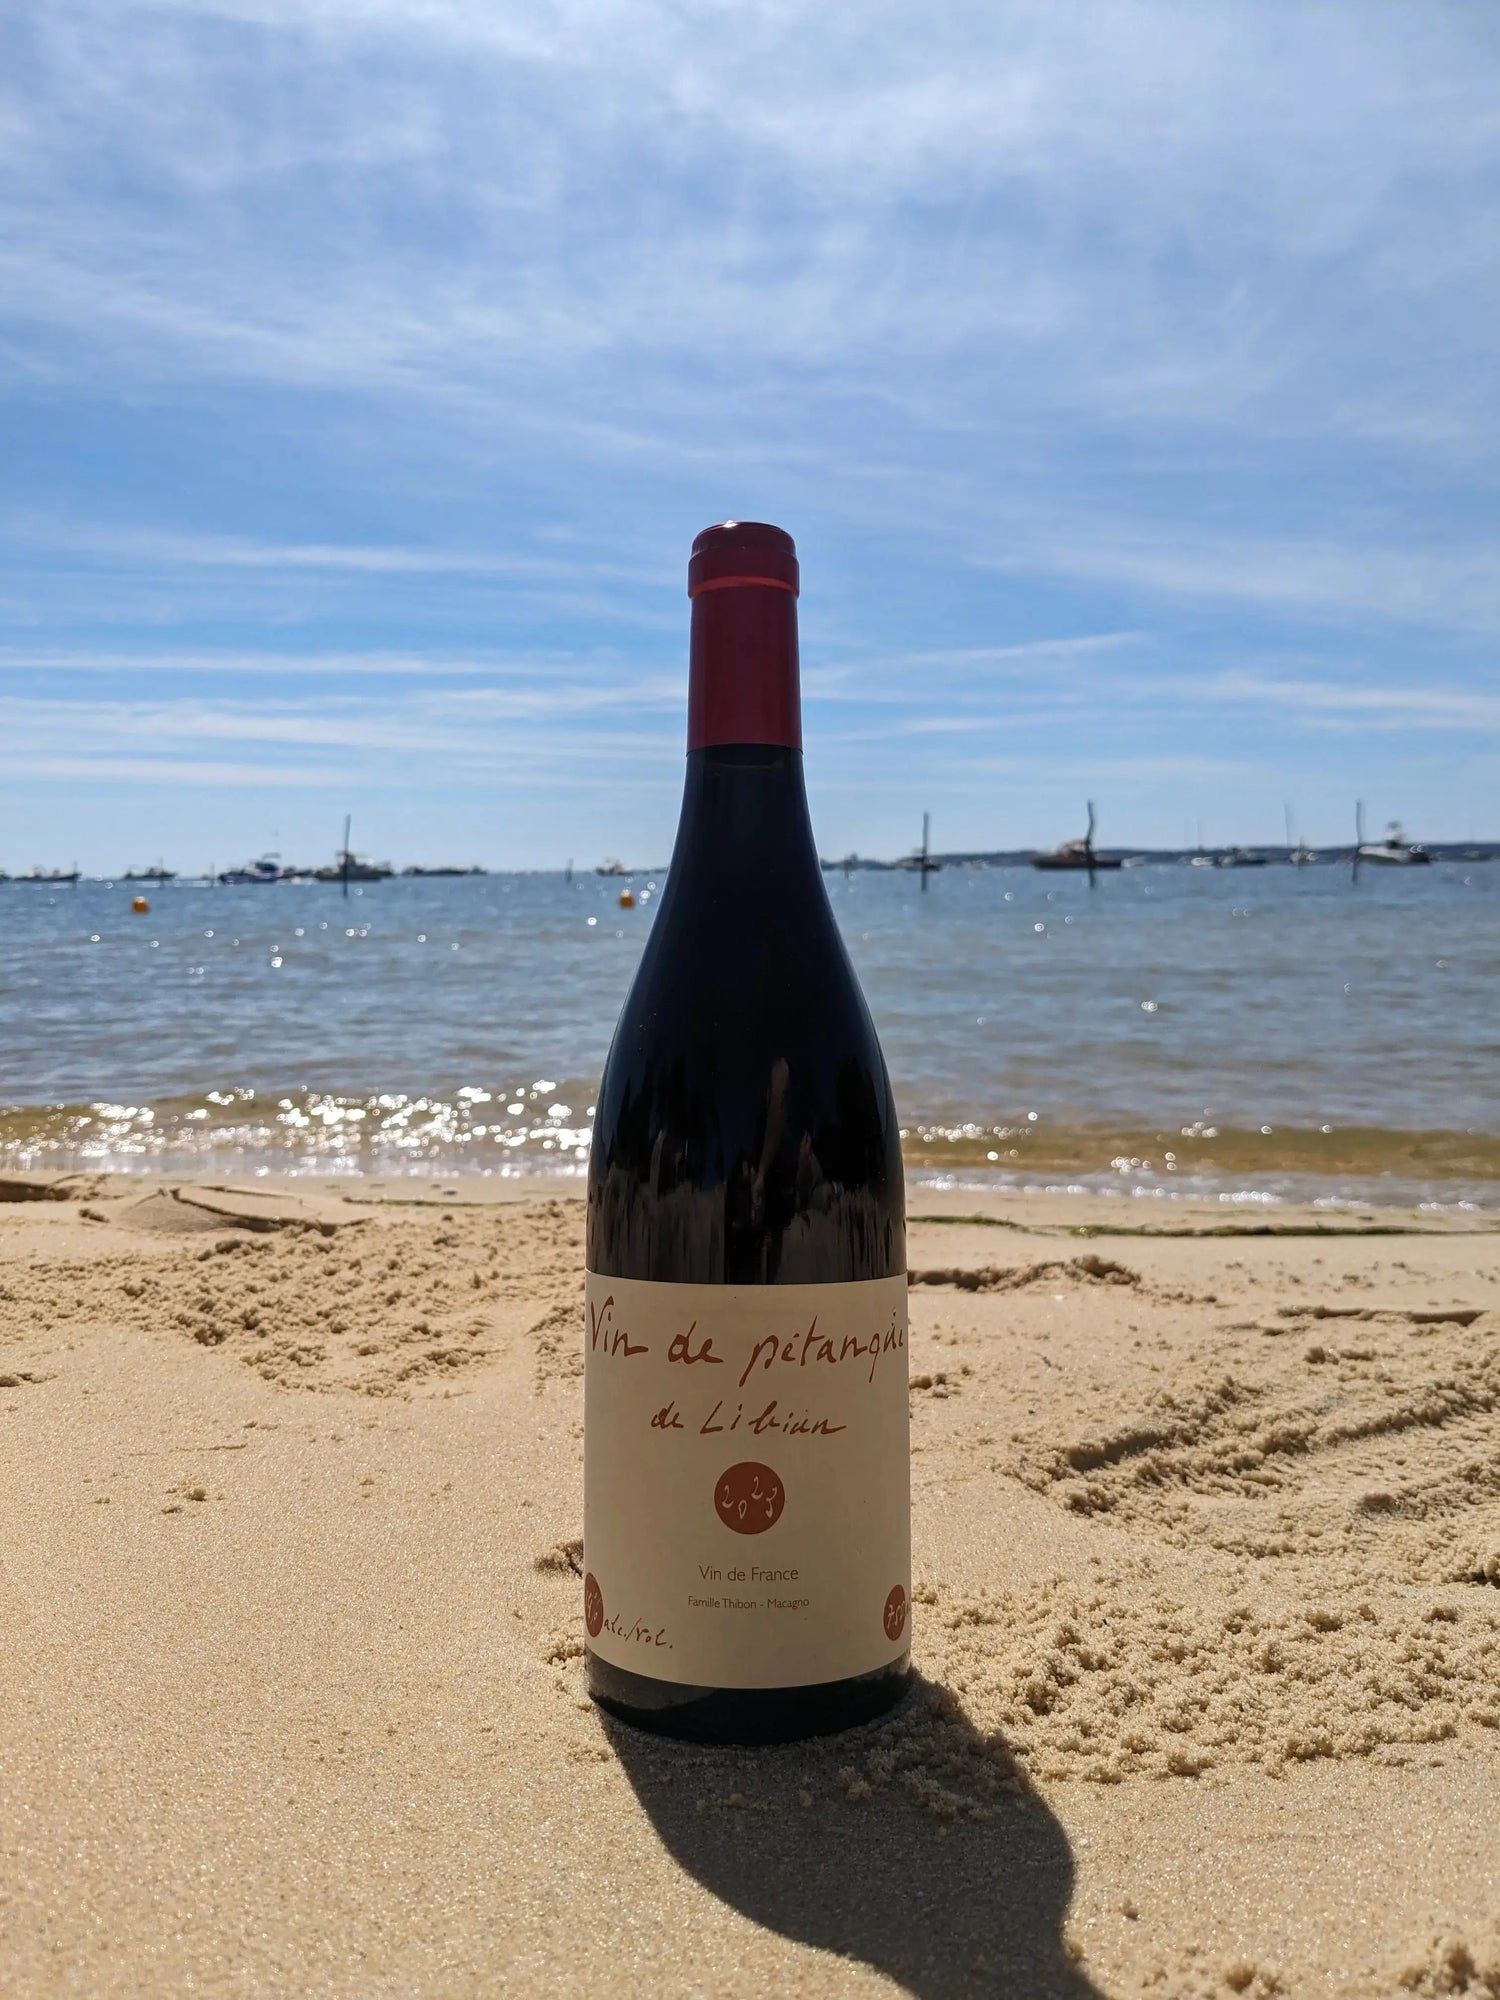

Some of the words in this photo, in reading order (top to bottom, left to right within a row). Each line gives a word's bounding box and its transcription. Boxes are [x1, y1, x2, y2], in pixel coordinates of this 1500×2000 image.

[591, 1296, 648, 1357] Vin
[667, 1321, 724, 1365] de
[650, 1401, 685, 1430] de
[699, 1400, 847, 1435] Libian
[722, 1475, 778, 1519] 2023
[698, 1565, 722, 1581] Vin
[727, 1567, 746, 1582] de
[751, 1566, 799, 1581] France
[687, 1595, 720, 1608] Famille
[721, 1598, 757, 1609] Thibon
[767, 1598, 810, 1611] Macagno
